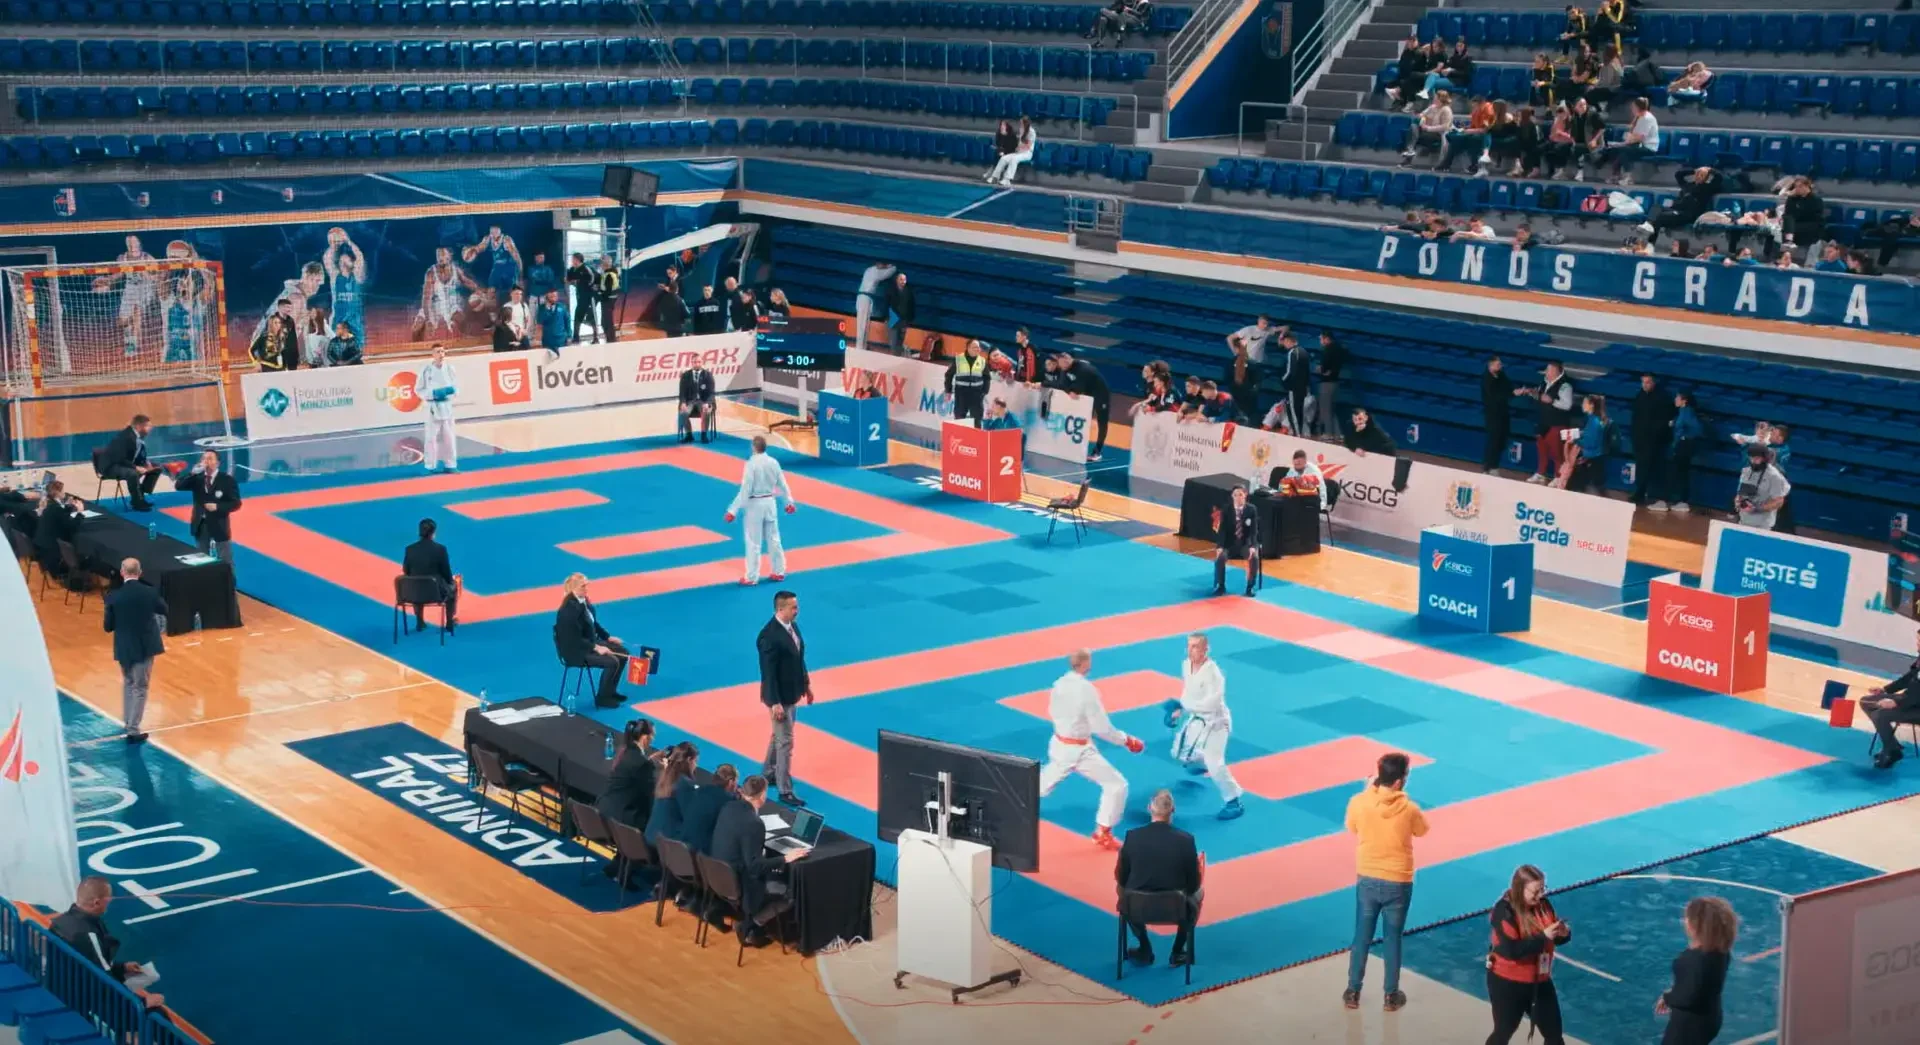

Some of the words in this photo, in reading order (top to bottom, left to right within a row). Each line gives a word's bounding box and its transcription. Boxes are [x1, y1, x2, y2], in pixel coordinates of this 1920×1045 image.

[1377, 235, 1575, 291] PONOS
[1632, 261, 1870, 326] GRADA
[537, 361, 614, 390] lovćen
[868, 422, 881, 441] 2
[825, 439, 855, 456] COACH
[1000, 455, 1015, 476] 2
[948, 472, 982, 491] COACH
[1339, 479, 1398, 508] KSCG
[1515, 501, 1555, 526] Srce
[1519, 523, 1570, 547] grada
[1742, 557, 1798, 585] ERSTE
[1502, 576, 1516, 601] 1
[1741, 577, 1767, 593] Bank
[1428, 593, 1478, 619] COACH
[1679, 612, 1714, 629] KSCG
[1743, 630, 1755, 656] 1
[1658, 648, 1719, 677] COACH
[351, 755, 598, 867] ADMIRAL
